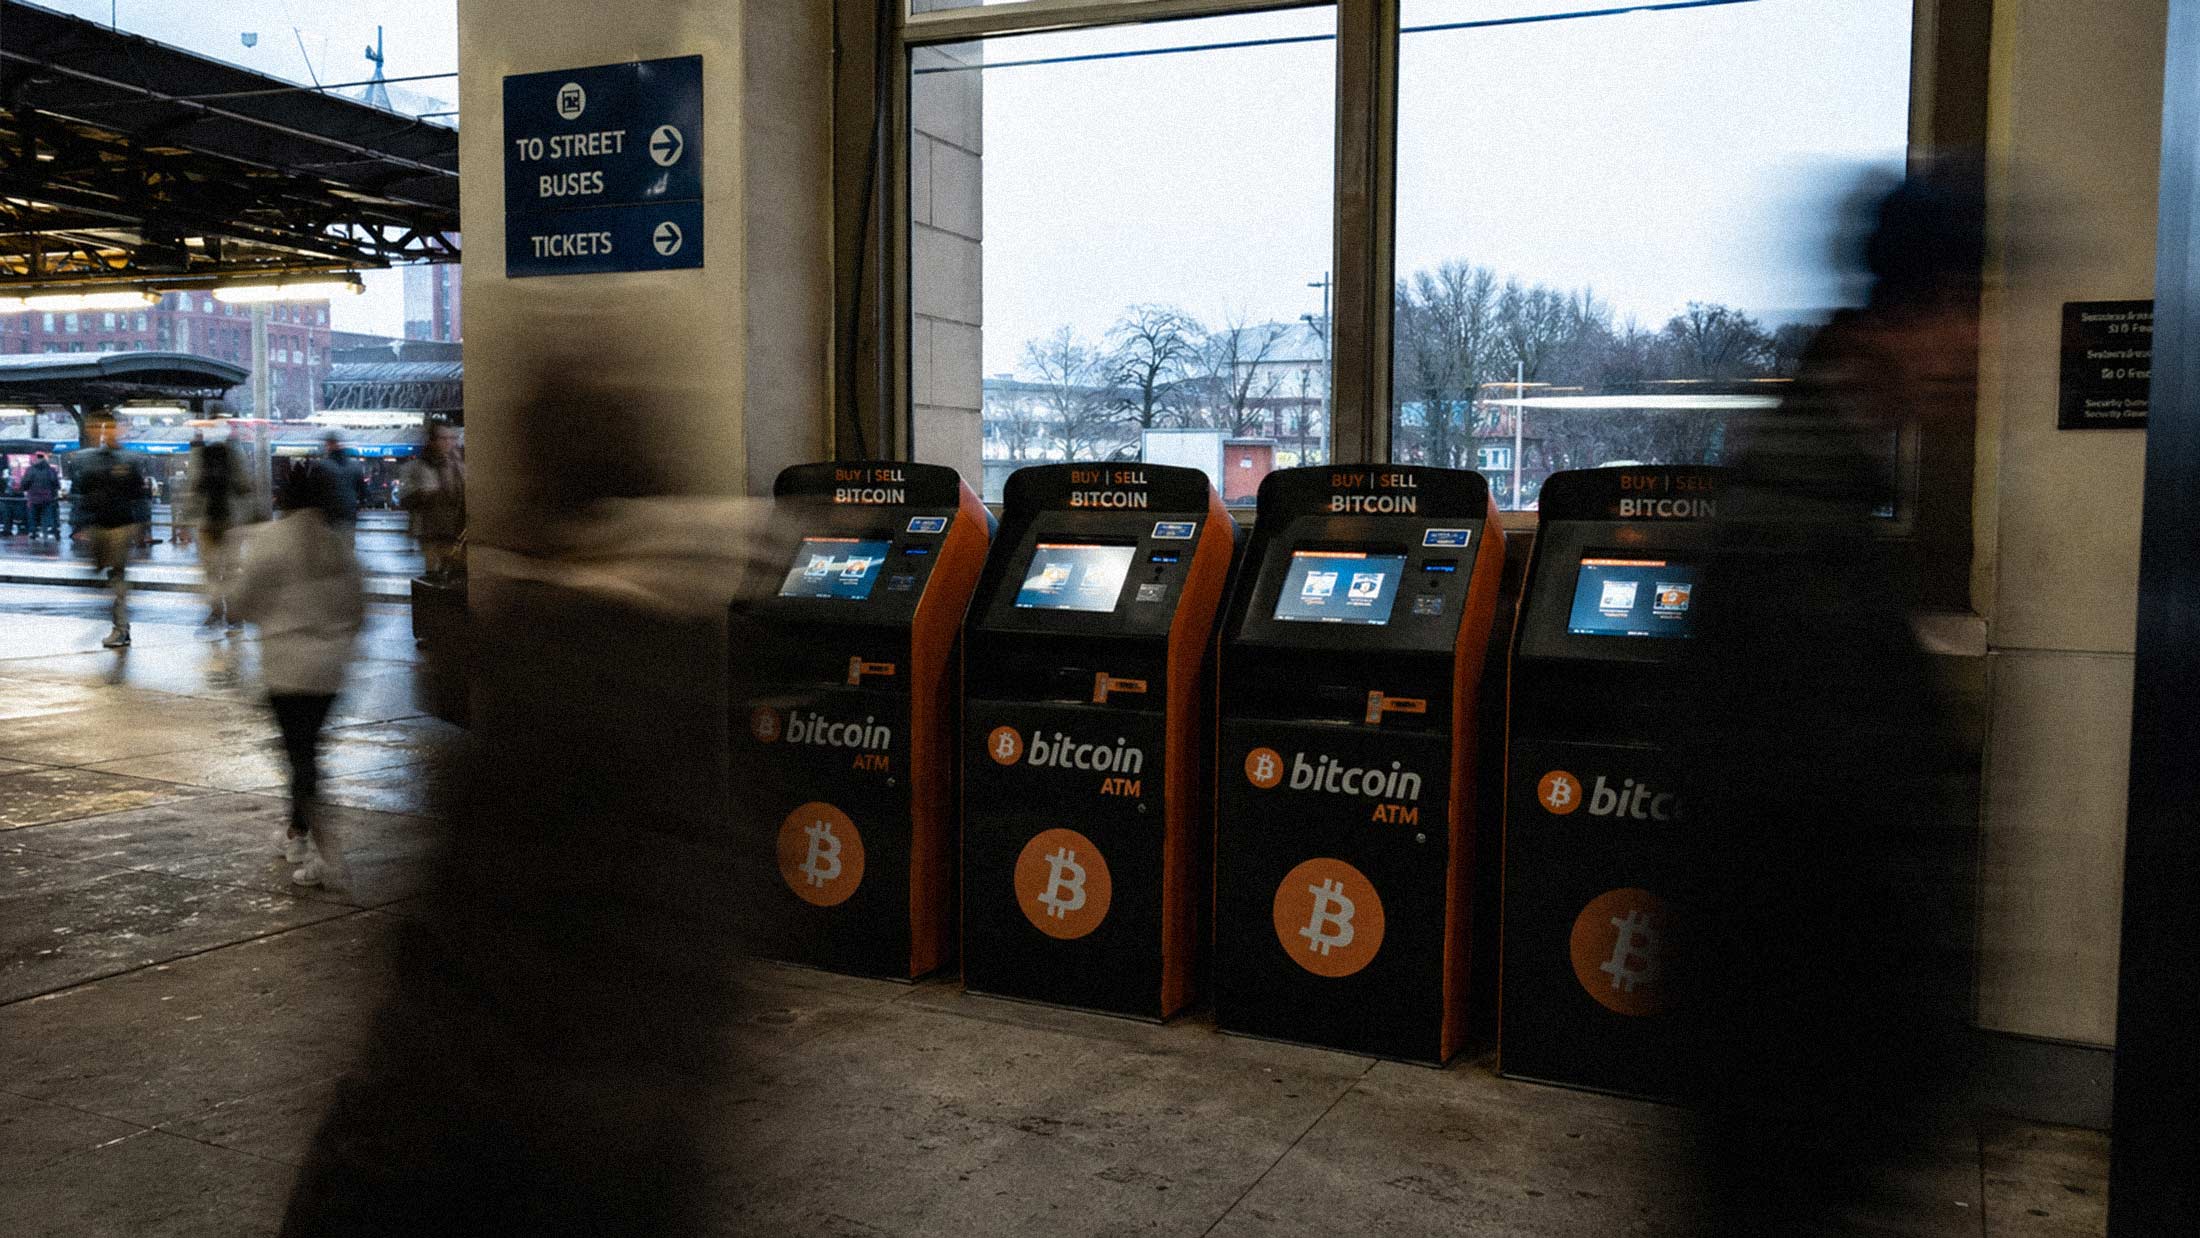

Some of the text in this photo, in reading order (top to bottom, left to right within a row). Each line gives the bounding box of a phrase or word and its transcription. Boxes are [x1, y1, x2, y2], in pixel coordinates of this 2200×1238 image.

[516, 130, 626, 161] TO STREET
[540, 171, 604, 198] BUSES
[531, 232, 612, 258] TICKETS
[835, 469, 863, 482] BUY
[875, 469, 905, 482] SELL
[1071, 471, 1100, 484] BUY
[1114, 471, 1147, 485] SELL
[1331, 473, 1365, 488] BUY
[1380, 474, 1417, 488] SELL
[1620, 474, 1657, 490] BUY
[835, 488, 905, 504] BITCOIN
[1071, 491, 1147, 508] BITCOIN
[1331, 495, 1417, 513] BITCOIN
[1619, 498, 1717, 518] BITCOIN
[786, 710, 892, 750] bitcoin
[1027, 730, 1144, 774] bitcoin
[852, 754, 890, 774] ATM
[1289, 751, 1423, 802] bitcoin
[1100, 777, 1142, 799] ATM
[1588, 774, 1678, 821] bitc
[1371, 803, 1420, 827] ATM
